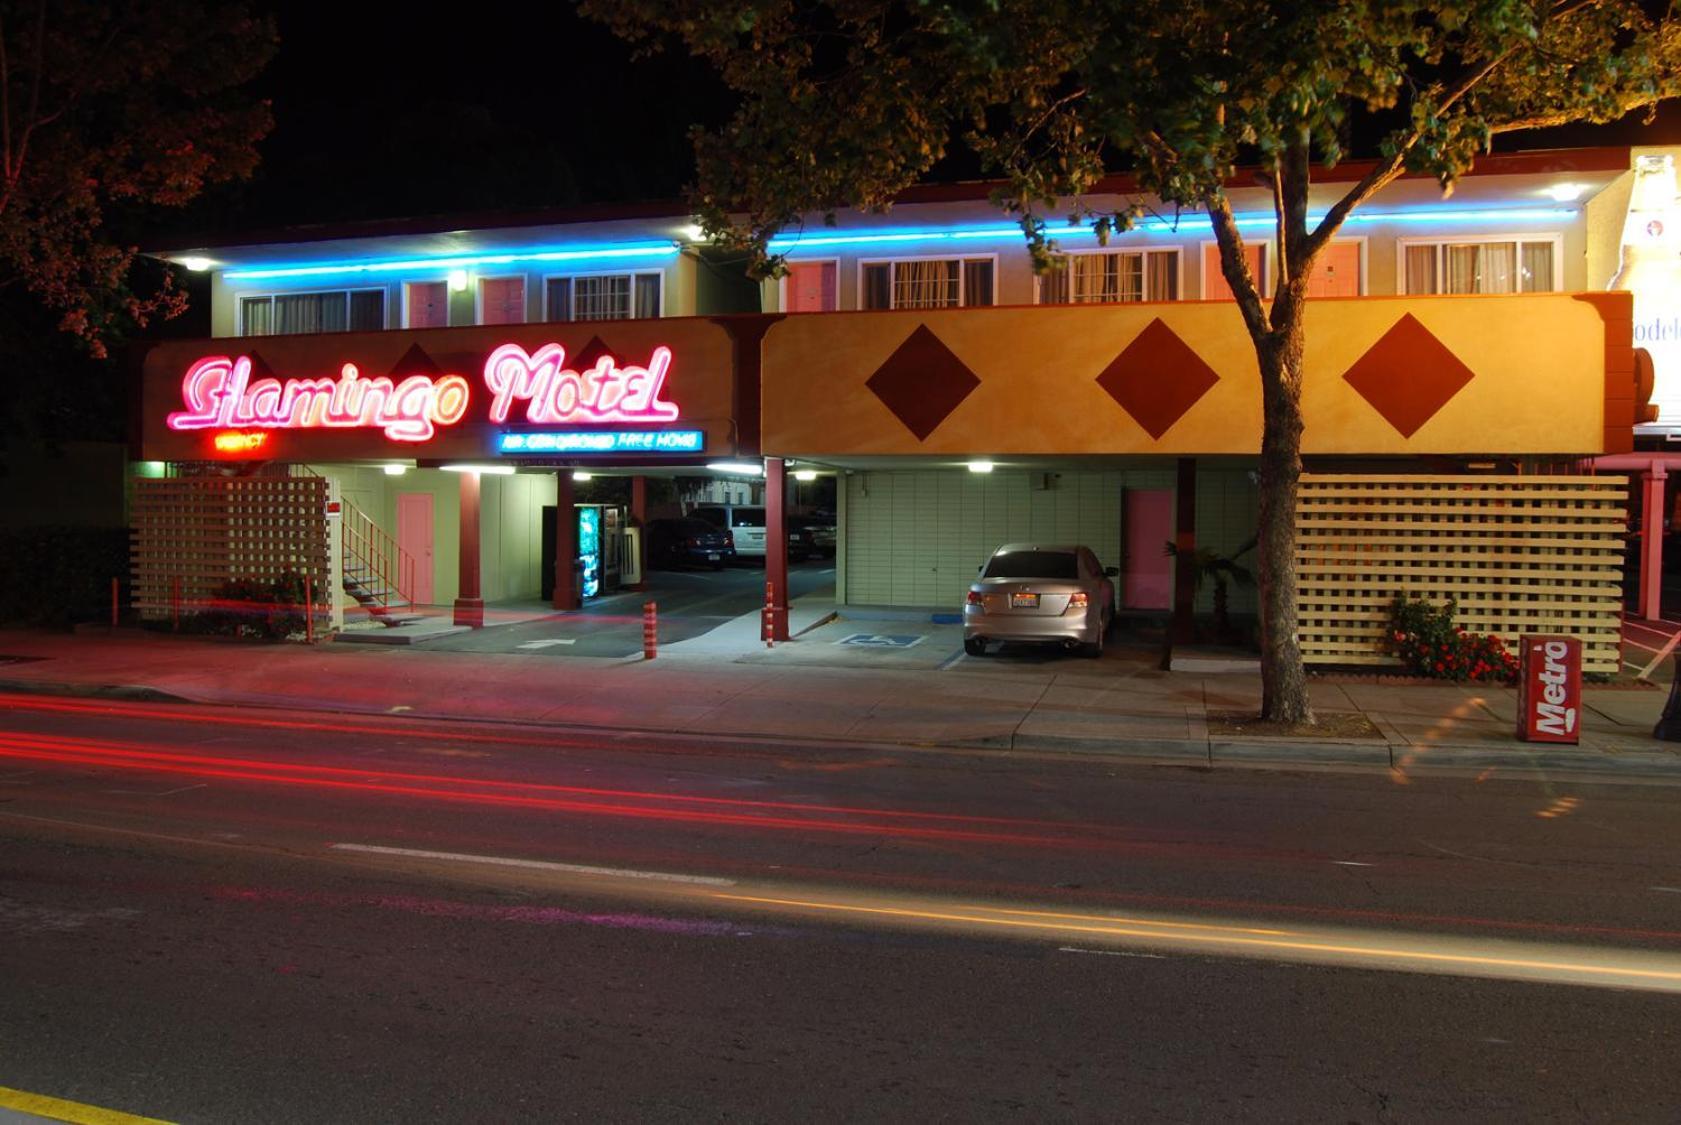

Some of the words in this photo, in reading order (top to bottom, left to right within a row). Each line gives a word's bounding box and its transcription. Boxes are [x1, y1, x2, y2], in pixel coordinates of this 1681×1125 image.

[1635, 317, 1681, 341] odel
[167, 355, 470, 442] Flamingo
[484, 343, 680, 424] Motel
[1536, 641, 1568, 736] Metro
